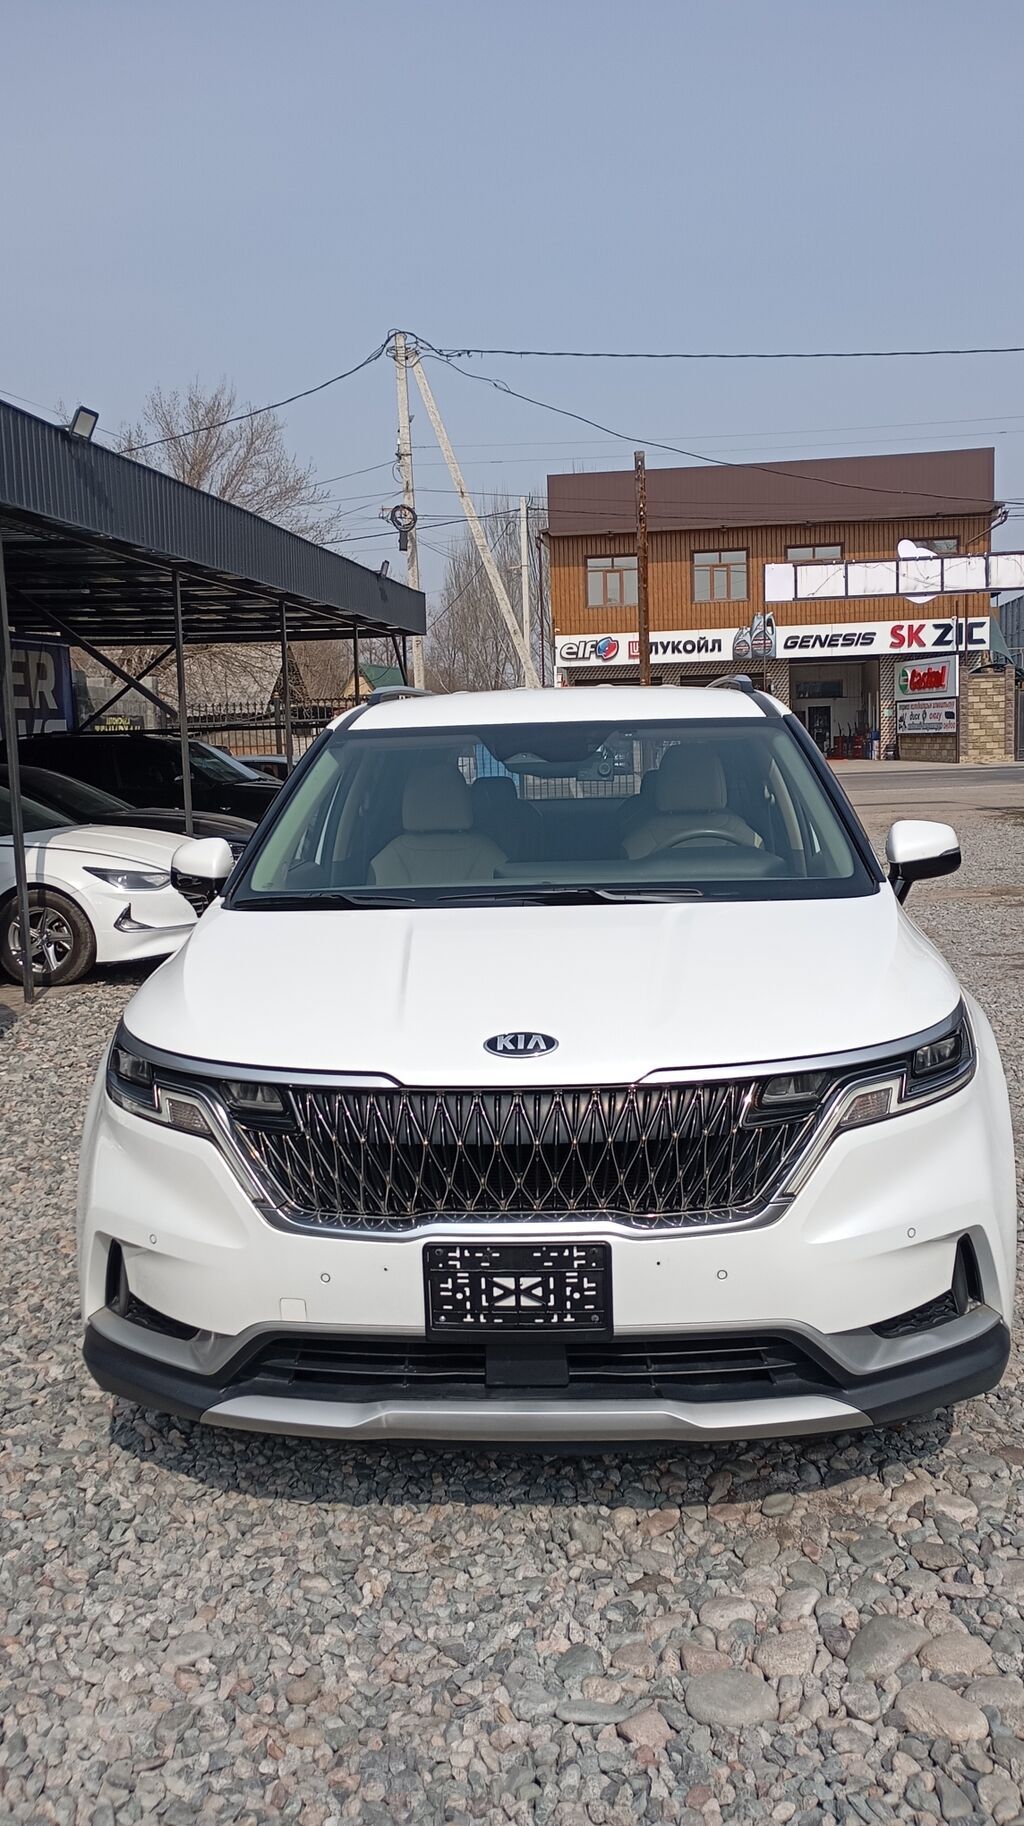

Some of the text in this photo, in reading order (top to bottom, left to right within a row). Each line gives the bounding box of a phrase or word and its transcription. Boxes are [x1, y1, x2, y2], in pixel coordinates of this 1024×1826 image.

[783, 632, 877, 649] GENESIS
[889, 622, 987, 649] SK ZIC
[560, 641, 597, 660] elf
[649, 637, 722, 656] ЛУКОЙЛ
[909, 666, 947, 691] Castrol
[496, 1034, 547, 1051] KIA
